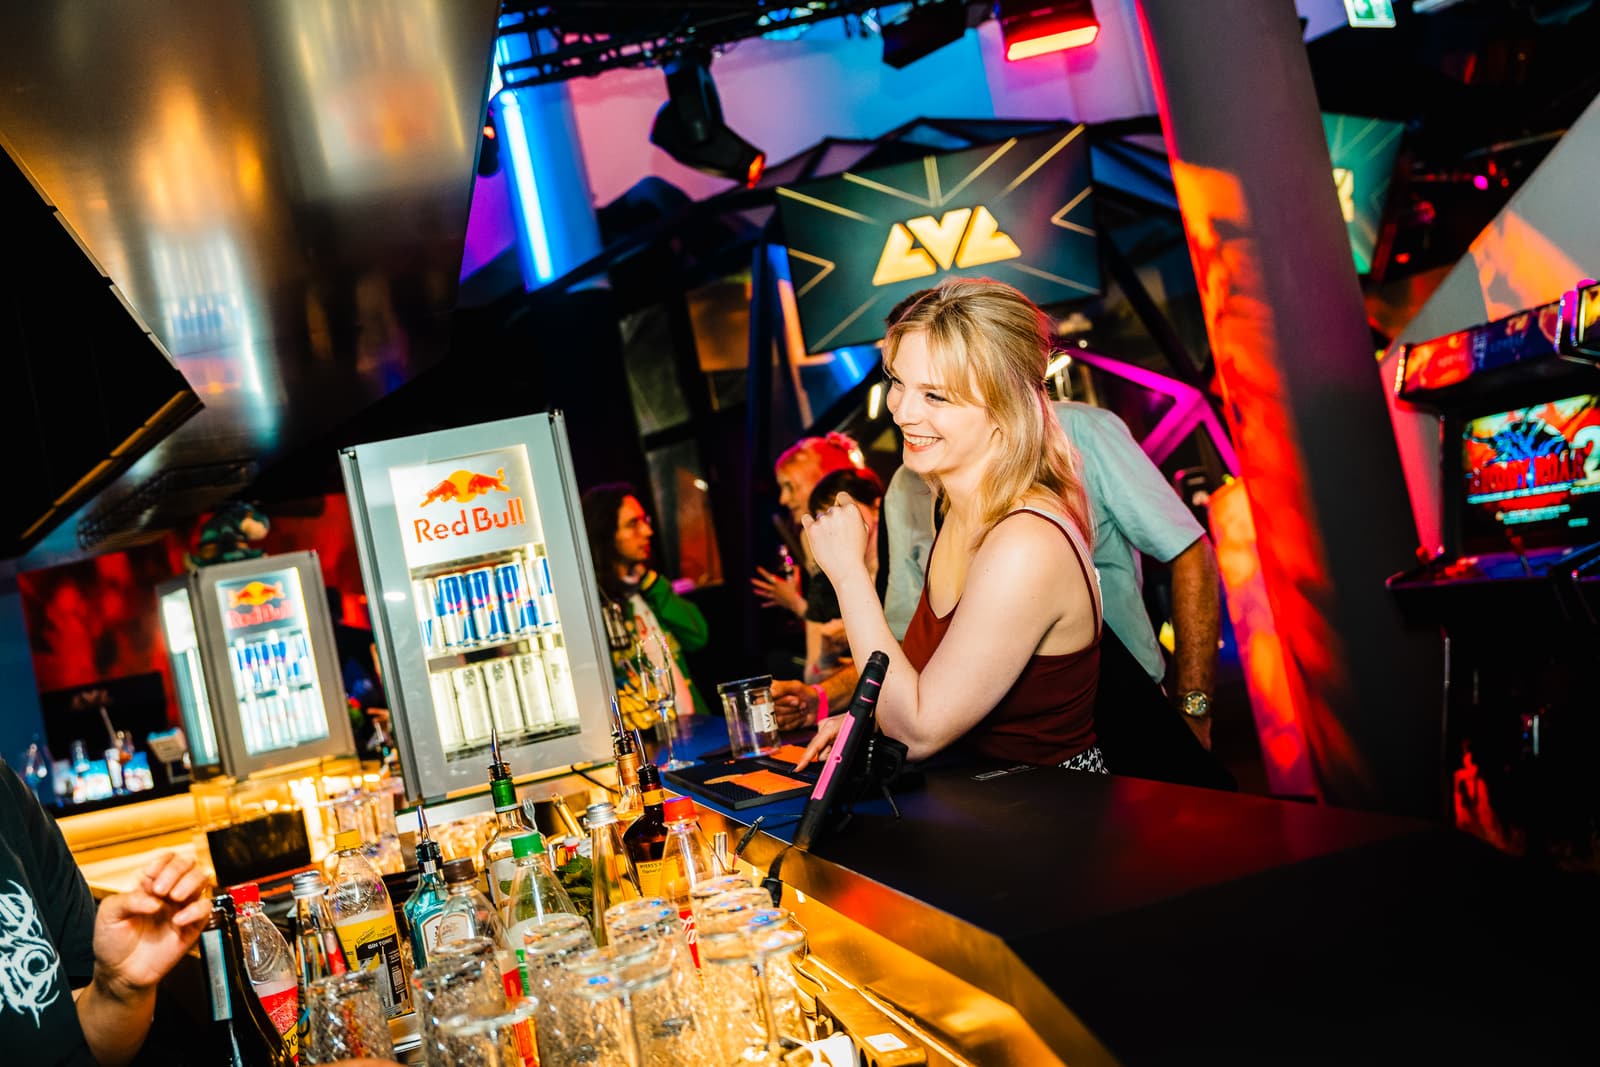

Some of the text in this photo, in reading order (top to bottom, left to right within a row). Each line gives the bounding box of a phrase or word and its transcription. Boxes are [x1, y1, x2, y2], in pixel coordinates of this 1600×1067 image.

[413, 496, 526, 544] Red Bull
[367, 942, 378, 950] GIN
